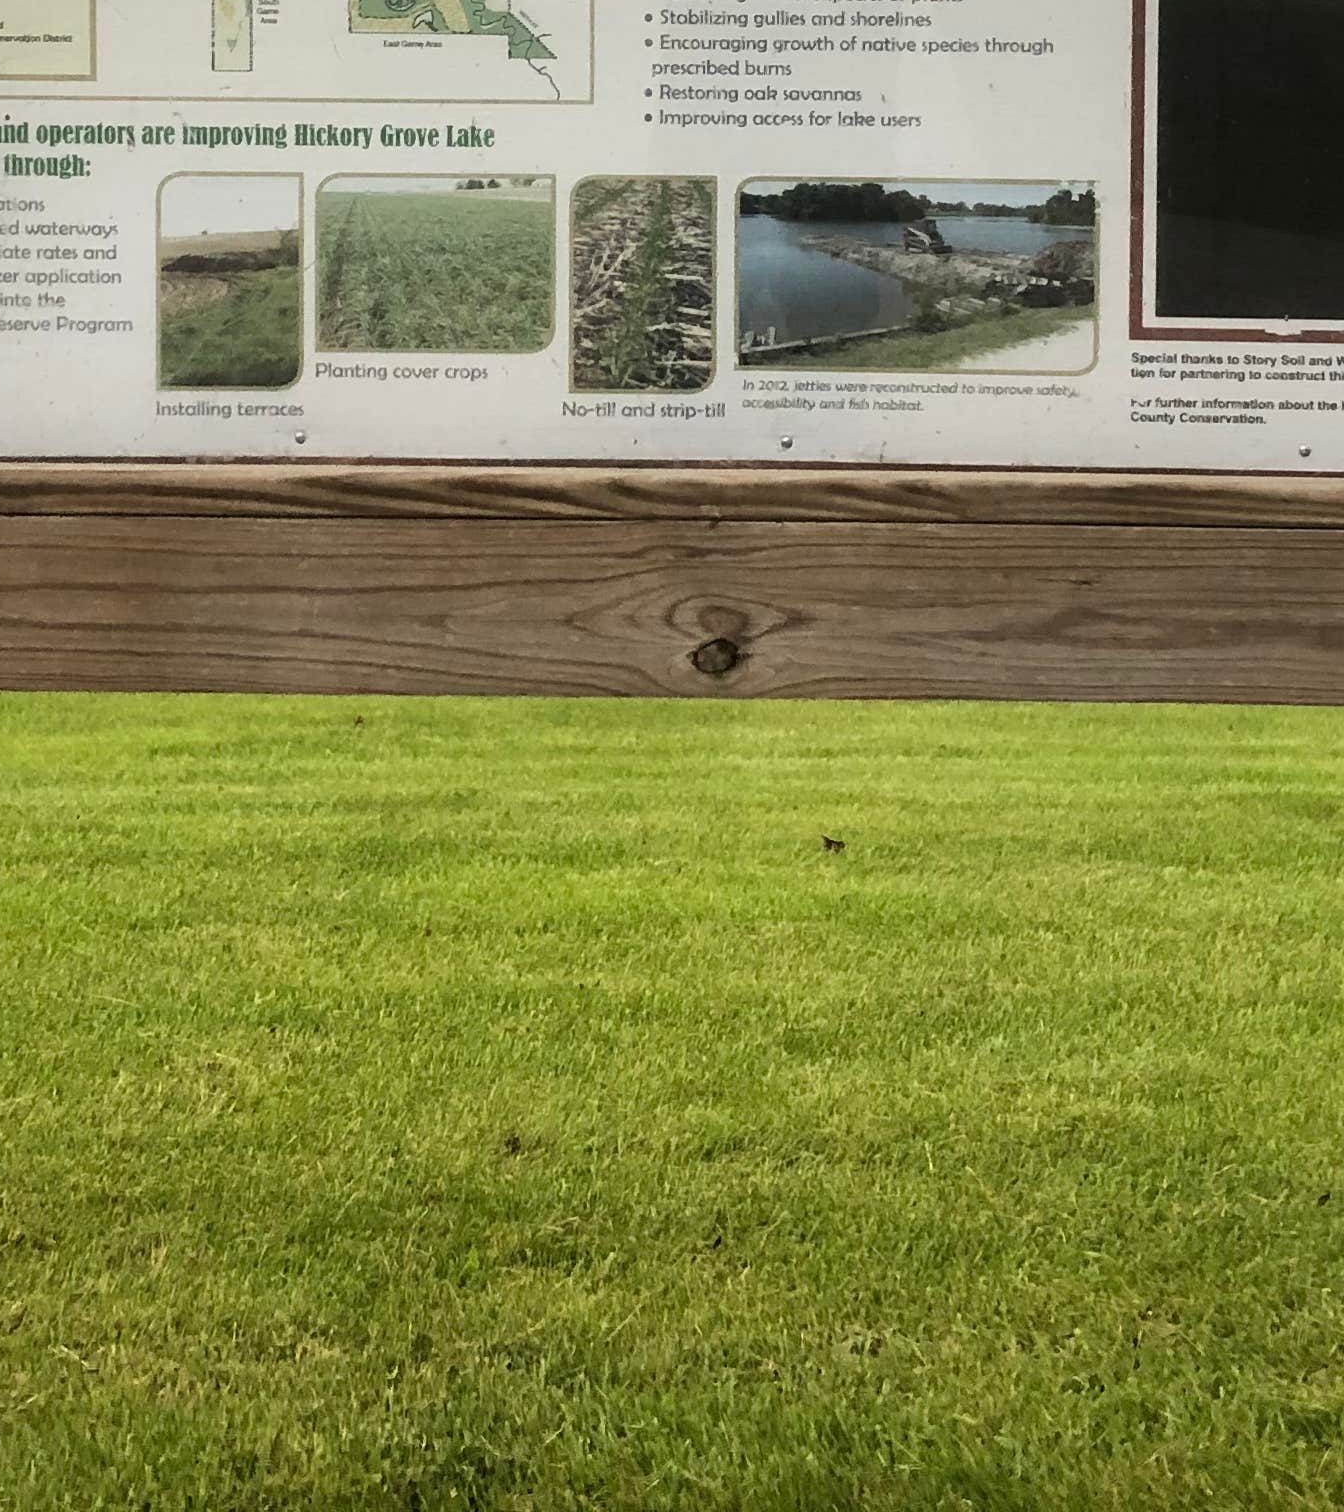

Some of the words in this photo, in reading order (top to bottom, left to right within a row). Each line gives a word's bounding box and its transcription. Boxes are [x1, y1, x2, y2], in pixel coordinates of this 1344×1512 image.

[660, 10, 748, 27] Stabilizing
[754, 10, 805, 27] gullies
[812, 11, 844, 26] and
[851, 11, 932, 26] shorelines
[660, 35, 766, 52] Encouraging
[773, 36, 833, 52] growth
[840, 36, 856, 51] of
[862, 37, 915, 51] native
[922, 38, 978, 54] species
[985, 37, 1052, 55] through
[652, 60, 739, 76] prescribed
[745, 60, 791, 75] burns
[659, 86, 738, 102] Restoring
[744, 86, 777, 100] oak
[783, 90, 862, 101] savannas
[36, 123, 134, 147] operators
[142, 126, 174, 144] are
[183, 123, 287, 148] improving
[295, 124, 372, 149] Hickory
[380, 124, 439, 147] Grove
[447, 125, 494, 147] Lake
[4, 154, 90, 179] through:
[315, 362, 387, 380] Planting
[392, 367, 438, 378] cover
[444, 367, 487, 381] crops
[1159, 368, 1175, 378] for
[1180, 369, 1244, 381] partnering
[1265, 370, 1324, 380] construct
[156, 401, 231, 418] Installing
[237, 402, 304, 416] terraces
[562, 401, 615, 416] No-till
[621, 402, 655, 417] and
[661, 402, 725, 419] strip-till
[1131, 412, 1175, 424] County
[1180, 412, 1266, 423] Conservation.
